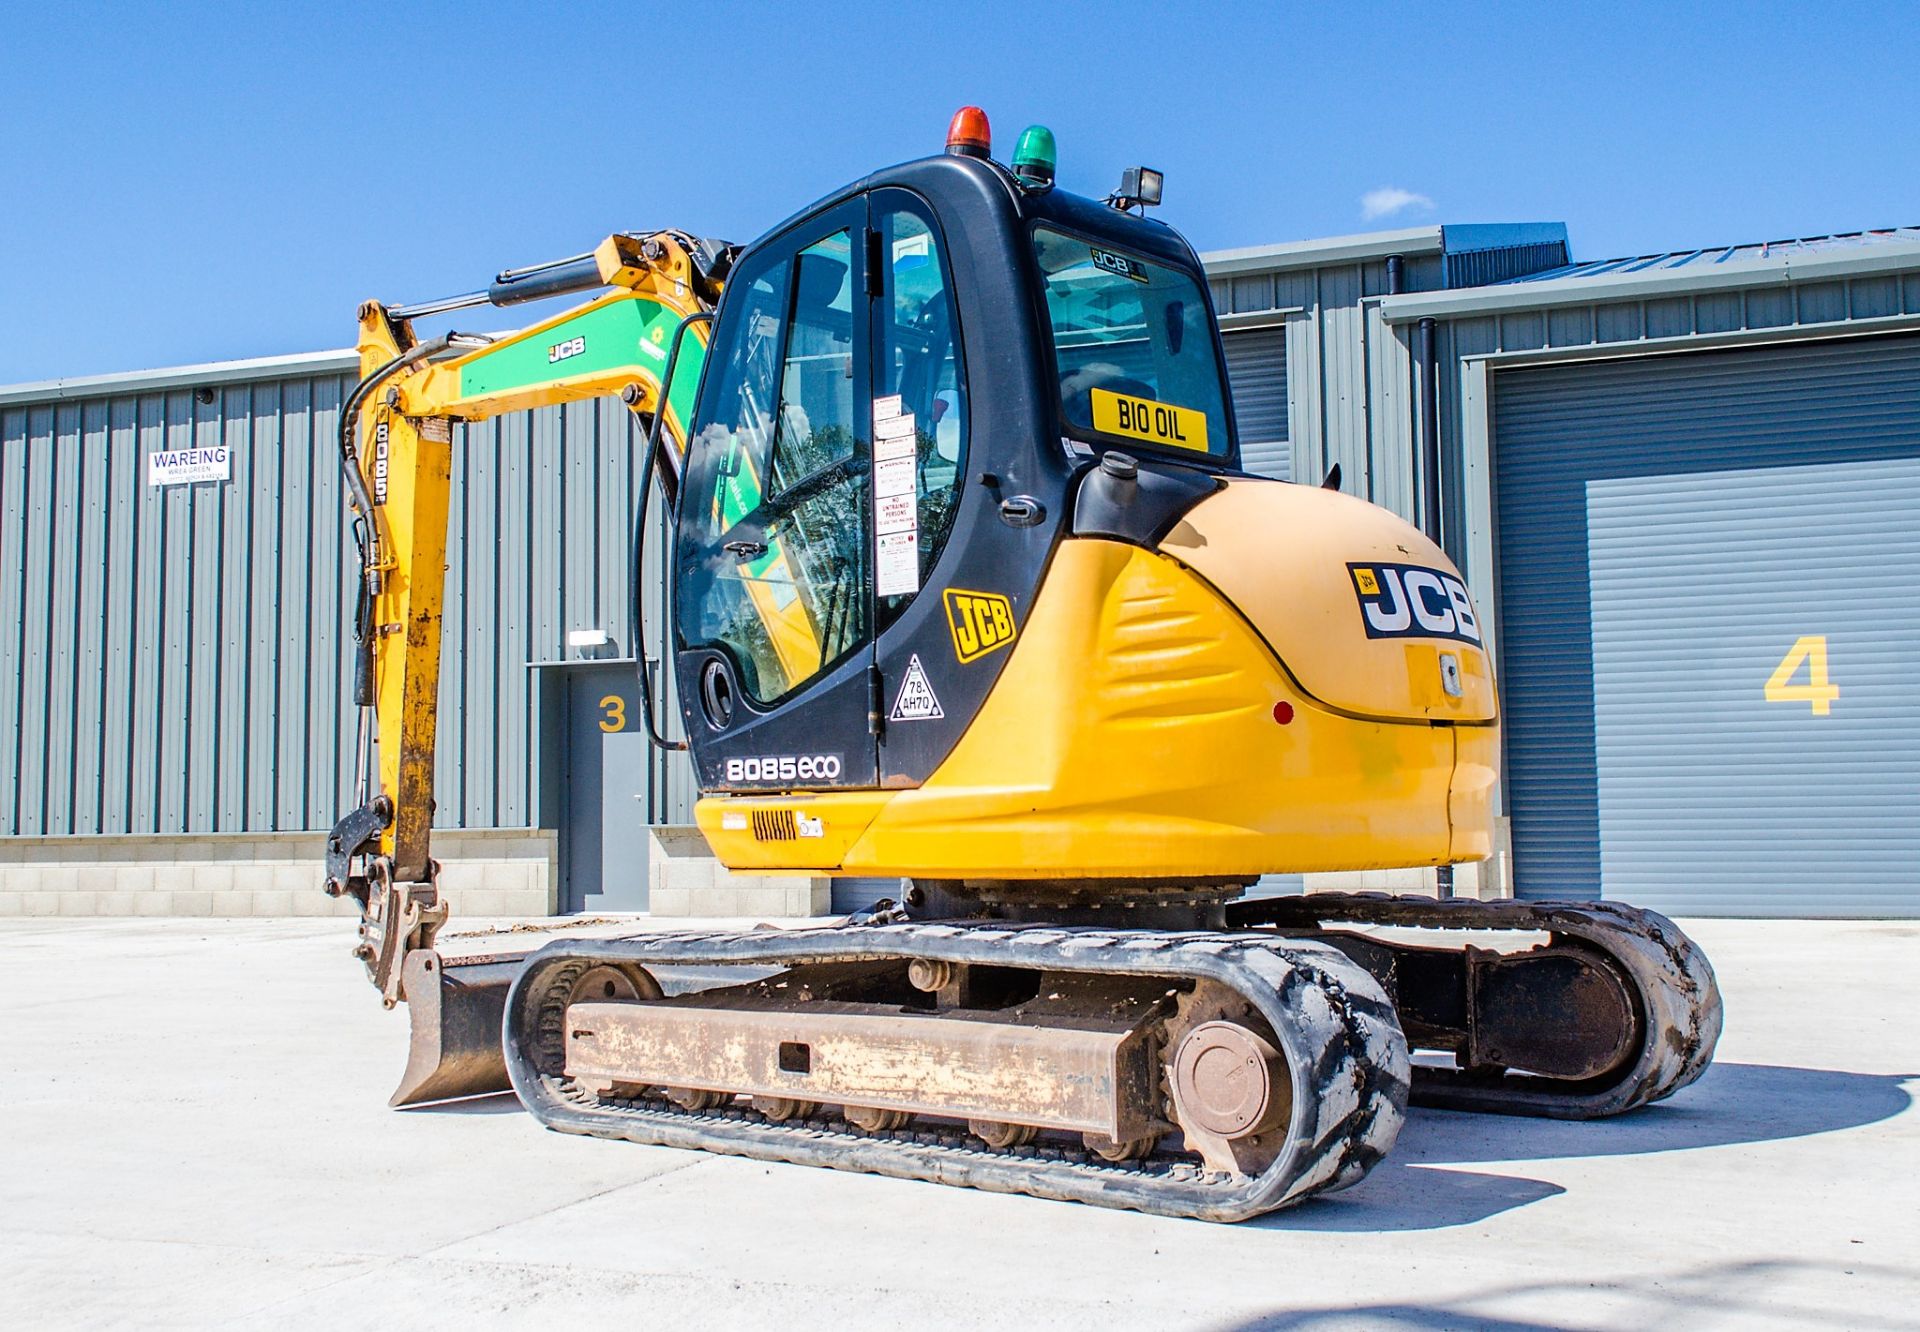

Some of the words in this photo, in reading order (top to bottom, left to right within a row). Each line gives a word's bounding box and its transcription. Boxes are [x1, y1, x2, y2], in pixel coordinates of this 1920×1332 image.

[1094, 251, 1129, 272] JCB
[549, 337, 585, 363] JCB
[154, 448, 226, 468] WAREING
[375, 423, 389, 496] 8085
[956, 596, 1011, 655] JCB
[1364, 568, 1480, 641] JCB
[1764, 636, 1840, 715] 4
[598, 695, 626, 733] 3
